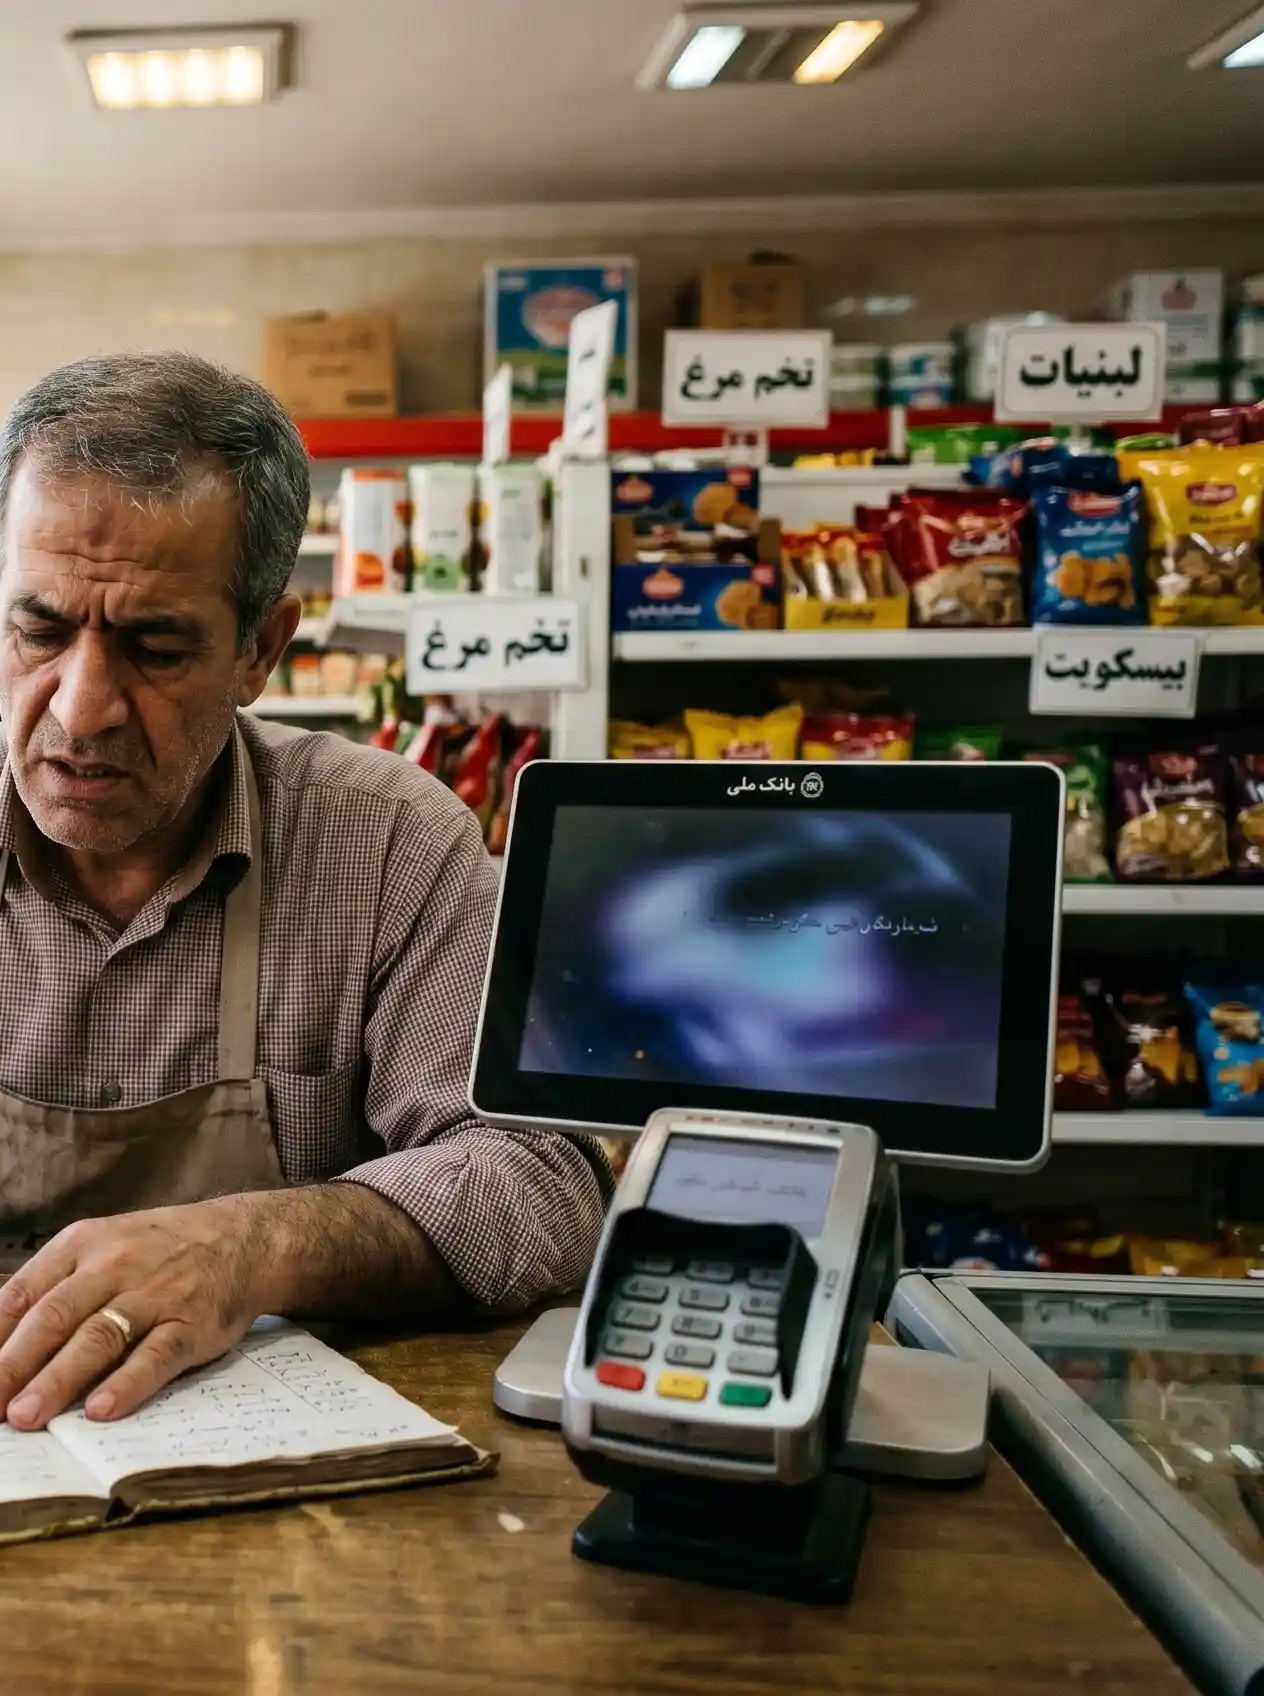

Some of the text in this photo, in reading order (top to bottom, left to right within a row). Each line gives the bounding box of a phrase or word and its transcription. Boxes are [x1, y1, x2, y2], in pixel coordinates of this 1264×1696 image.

[681, 354, 742, 400] مرغ
[1019, 344, 1142, 399] لبنیات
[422, 619, 570, 671] تخم مرغ
[1045, 647, 1186, 691] بیسکویت
[726, 776, 756, 796] ملی
[758, 777, 796, 796] بانک
